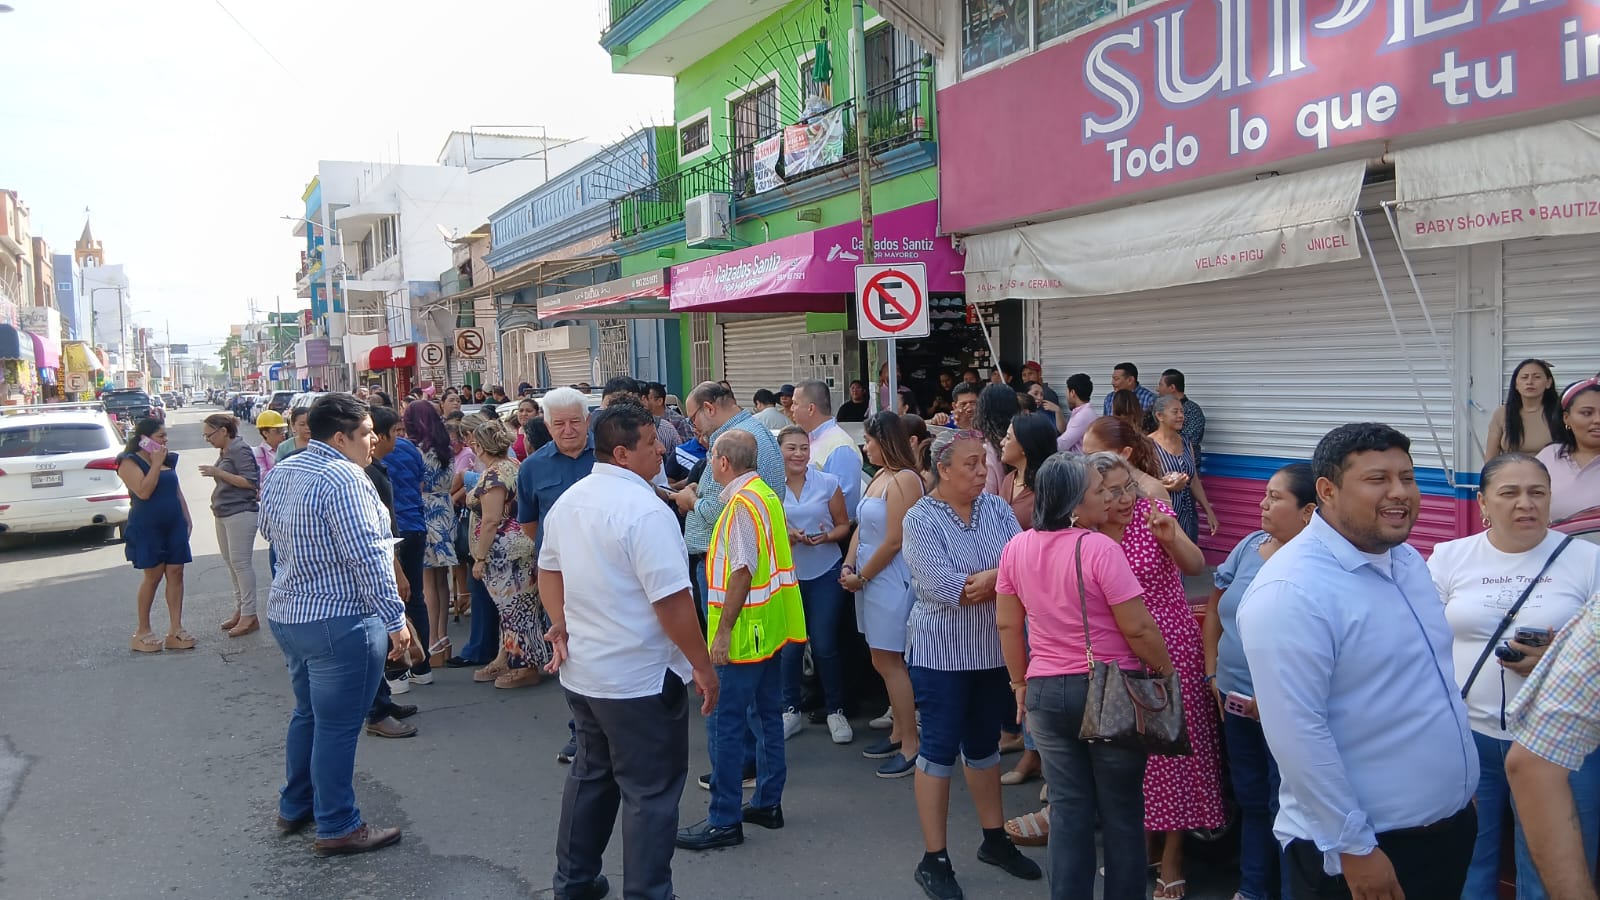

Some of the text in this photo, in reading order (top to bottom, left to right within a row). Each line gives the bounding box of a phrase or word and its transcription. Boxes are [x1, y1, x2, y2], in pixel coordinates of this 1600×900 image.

[1106, 126, 1199, 183] Todo
[1229, 108, 1268, 155] lo
[1296, 84, 1398, 149] que
[1432, 51, 1513, 104] tu
[1416, 219, 1454, 235] BABY
[1539, 201, 1600, 220] BAUTIZ
[852, 236, 935, 251] Caados Santiz
[884, 251, 919, 259] MAYOREO
[1195, 254, 1228, 270] VELAS
[715, 252, 781, 284] Calzados Santiz
[879, 281, 908, 321] E
[427, 347, 438, 361] E
[1482, 576, 1513, 585] Double
